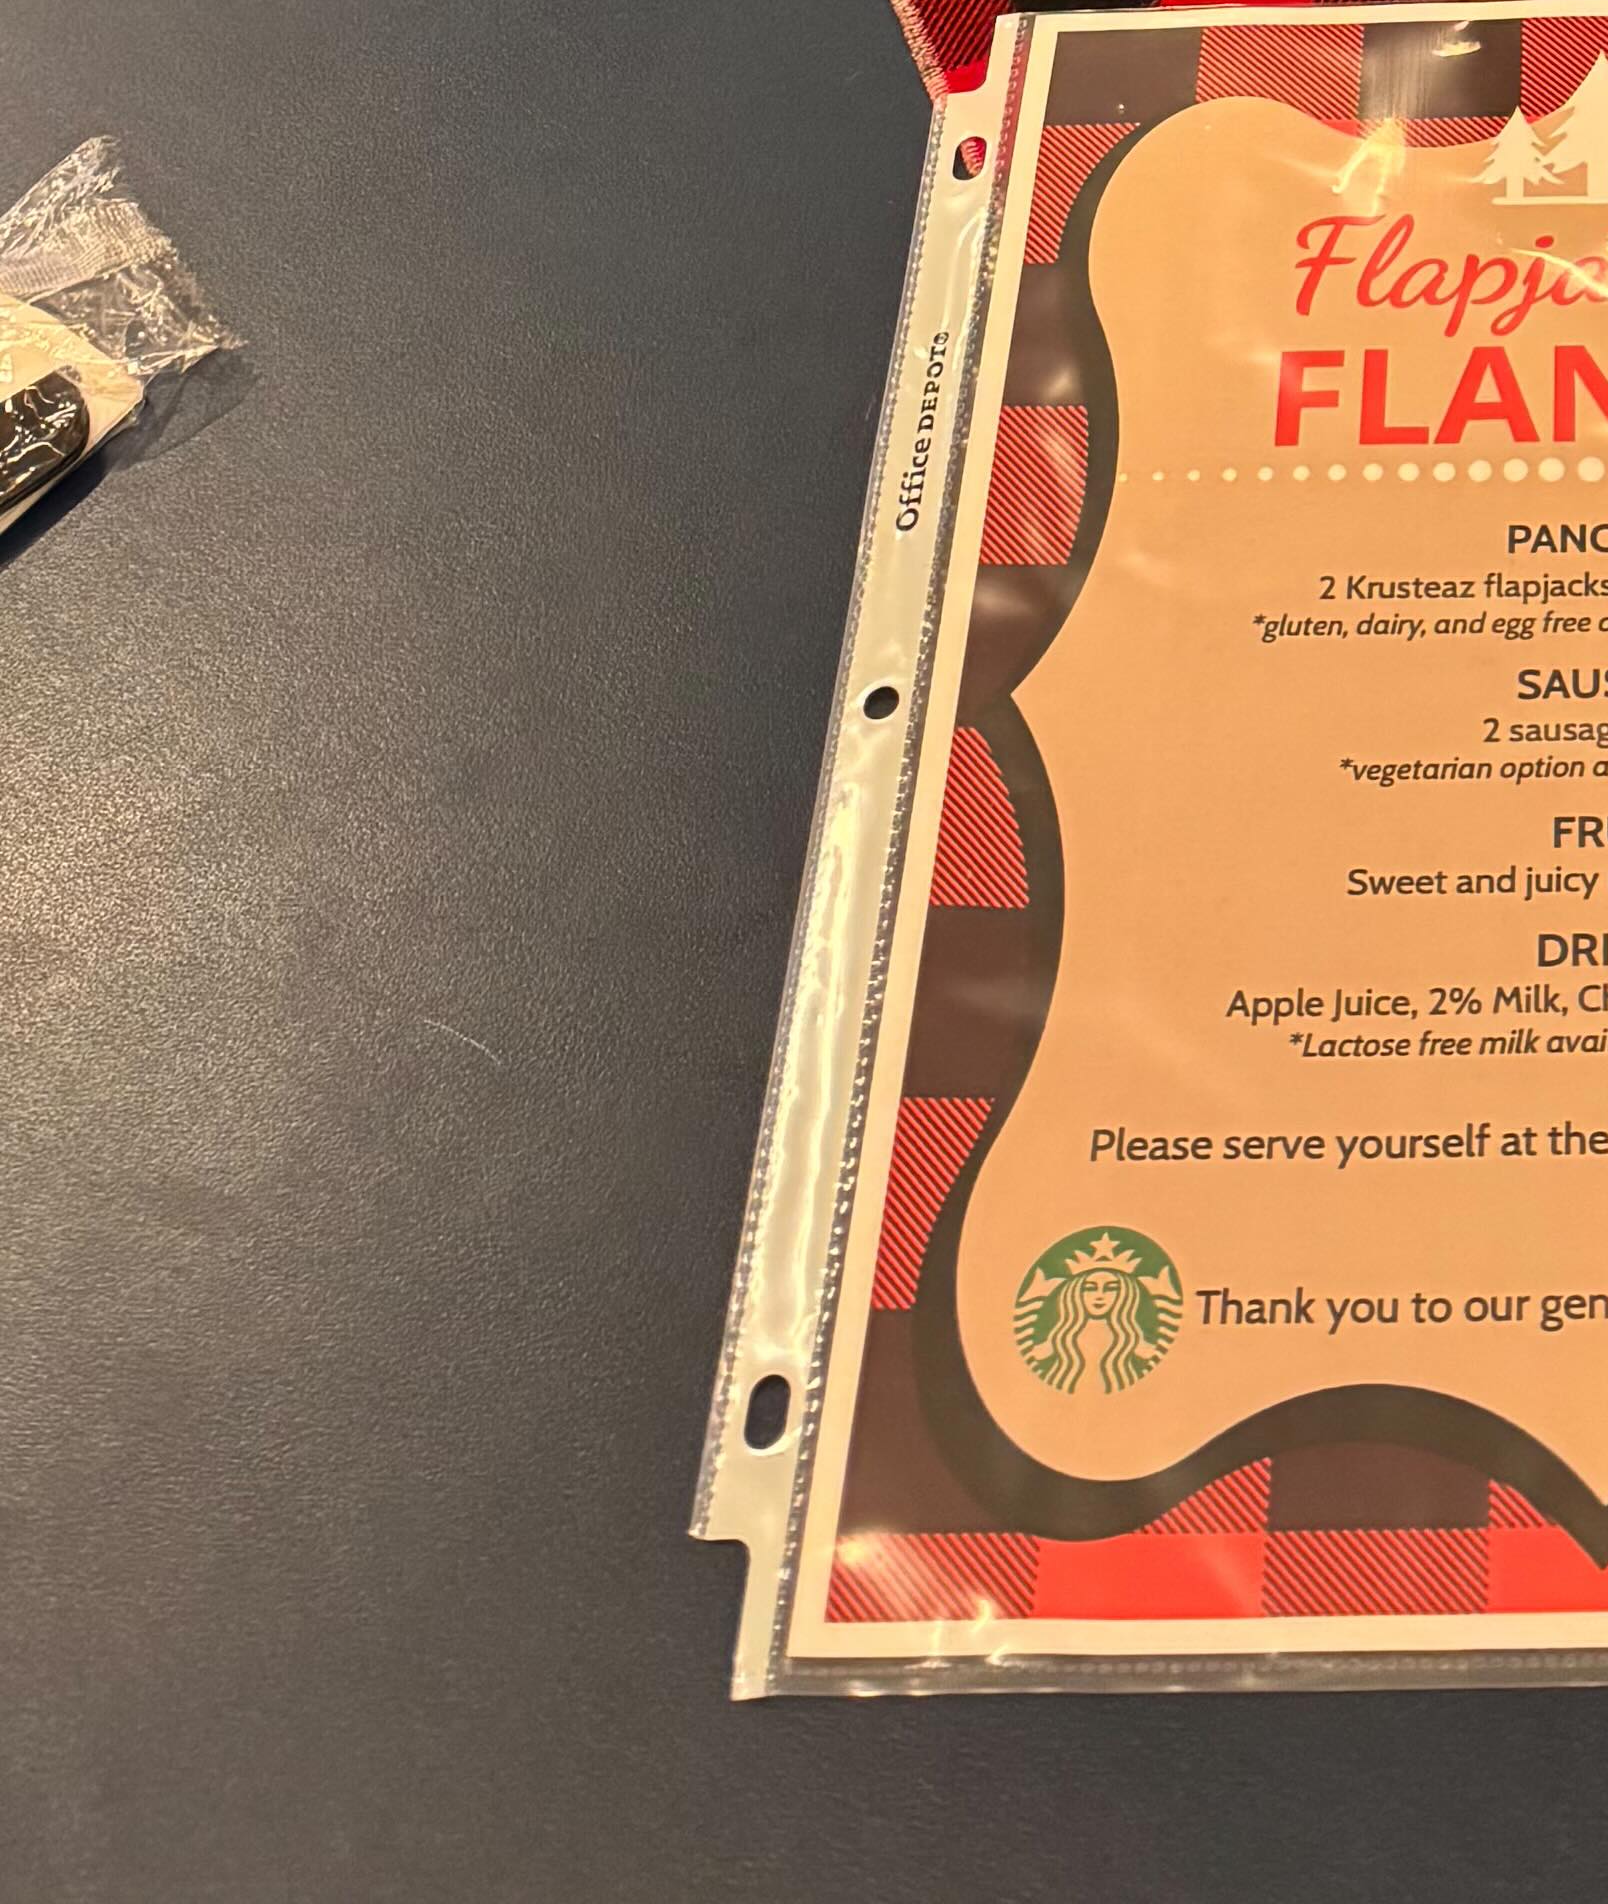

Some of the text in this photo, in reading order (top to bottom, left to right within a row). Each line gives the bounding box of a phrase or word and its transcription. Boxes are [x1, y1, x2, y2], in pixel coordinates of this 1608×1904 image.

[895, 437, 932, 533] Office
[1319, 574, 1337, 600] 2
[1346, 574, 1477, 600] Krusteaz
[1355, 610, 1427, 642] dairy,
[1433, 610, 1488, 634] and
[1490, 614, 1538, 641] egg
[1540, 607, 1592, 633] free
[1482, 716, 1502, 742] 2
[1499, 753, 1586, 786] option
[1346, 867, 1449, 896] Sweet
[1455, 863, 1517, 895] and
[1523, 864, 1600, 902] juicy
[1225, 986, 1325, 1027] Apple
[1329, 987, 1419, 1024] Juice,
[1428, 986, 1483, 1016] 2%
[1492, 983, 1569, 1016] Milk,
[1418, 1028, 1473, 1056] free
[1478, 1027, 1542, 1056] milk
[1090, 1126, 1214, 1162] Please
[1222, 1134, 1326, 1160] serve
[1334, 1121, 1492, 1170] yourself
[1500, 1126, 1539, 1157] at
[1194, 1286, 1316, 1325] Thank
[1325, 1296, 1399, 1334] you
[1410, 1292, 1453, 1324] to
[1463, 1294, 1531, 1323] our
